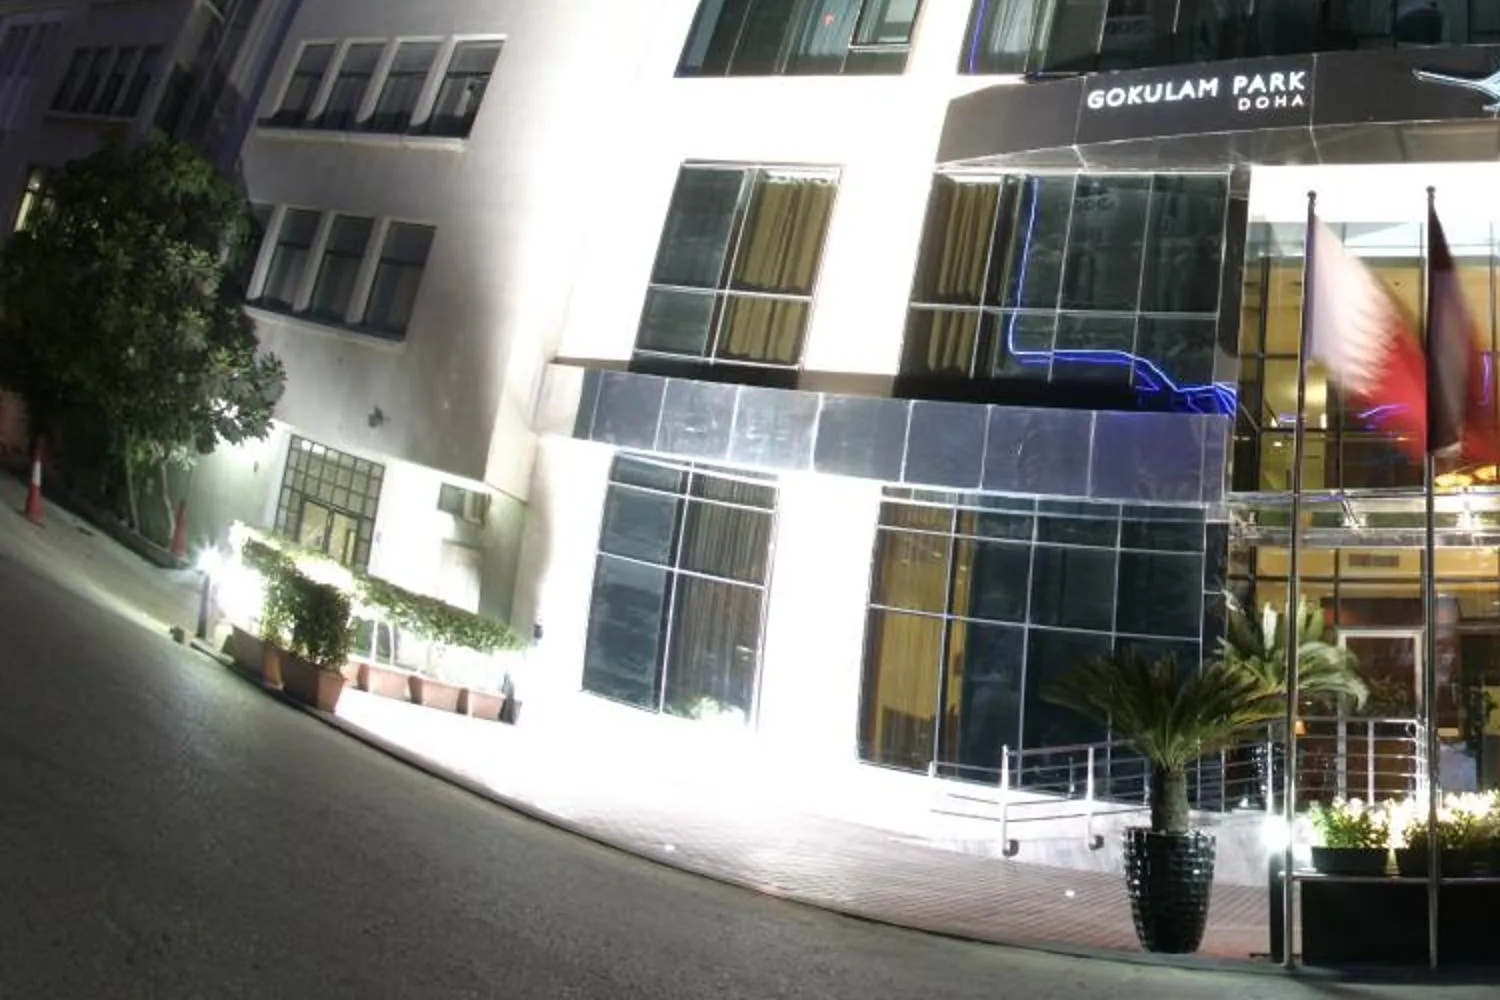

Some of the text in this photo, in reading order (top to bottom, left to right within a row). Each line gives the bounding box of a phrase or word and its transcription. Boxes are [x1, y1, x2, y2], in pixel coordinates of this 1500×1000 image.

[1086, 71, 1306, 110] GOKULAM PARK
[1237, 93, 1305, 112] DOHA
